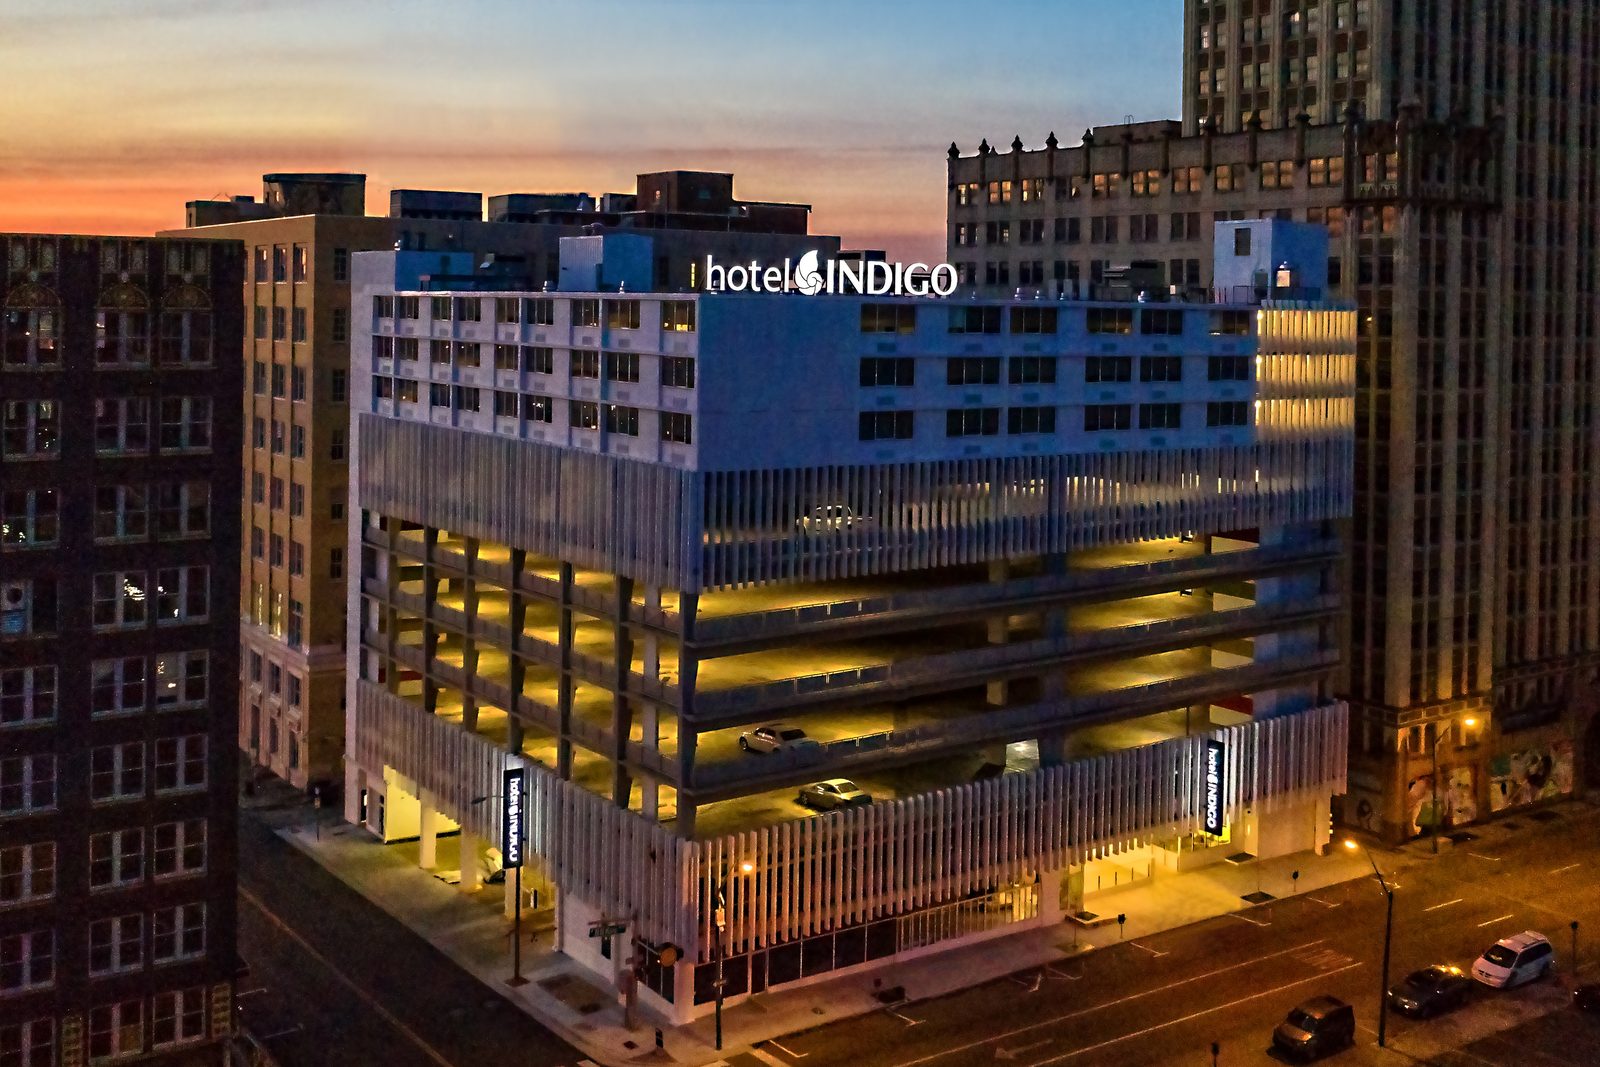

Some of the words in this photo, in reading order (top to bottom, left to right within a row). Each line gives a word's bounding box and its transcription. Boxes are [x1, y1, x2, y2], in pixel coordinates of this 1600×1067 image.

[706, 254, 790, 292] hotel
[827, 259, 958, 296] INDIGO
[1208, 748, 1219, 776] hotel
[509, 777, 520, 806] hotel
[1207, 781, 1218, 829] INDIGO
